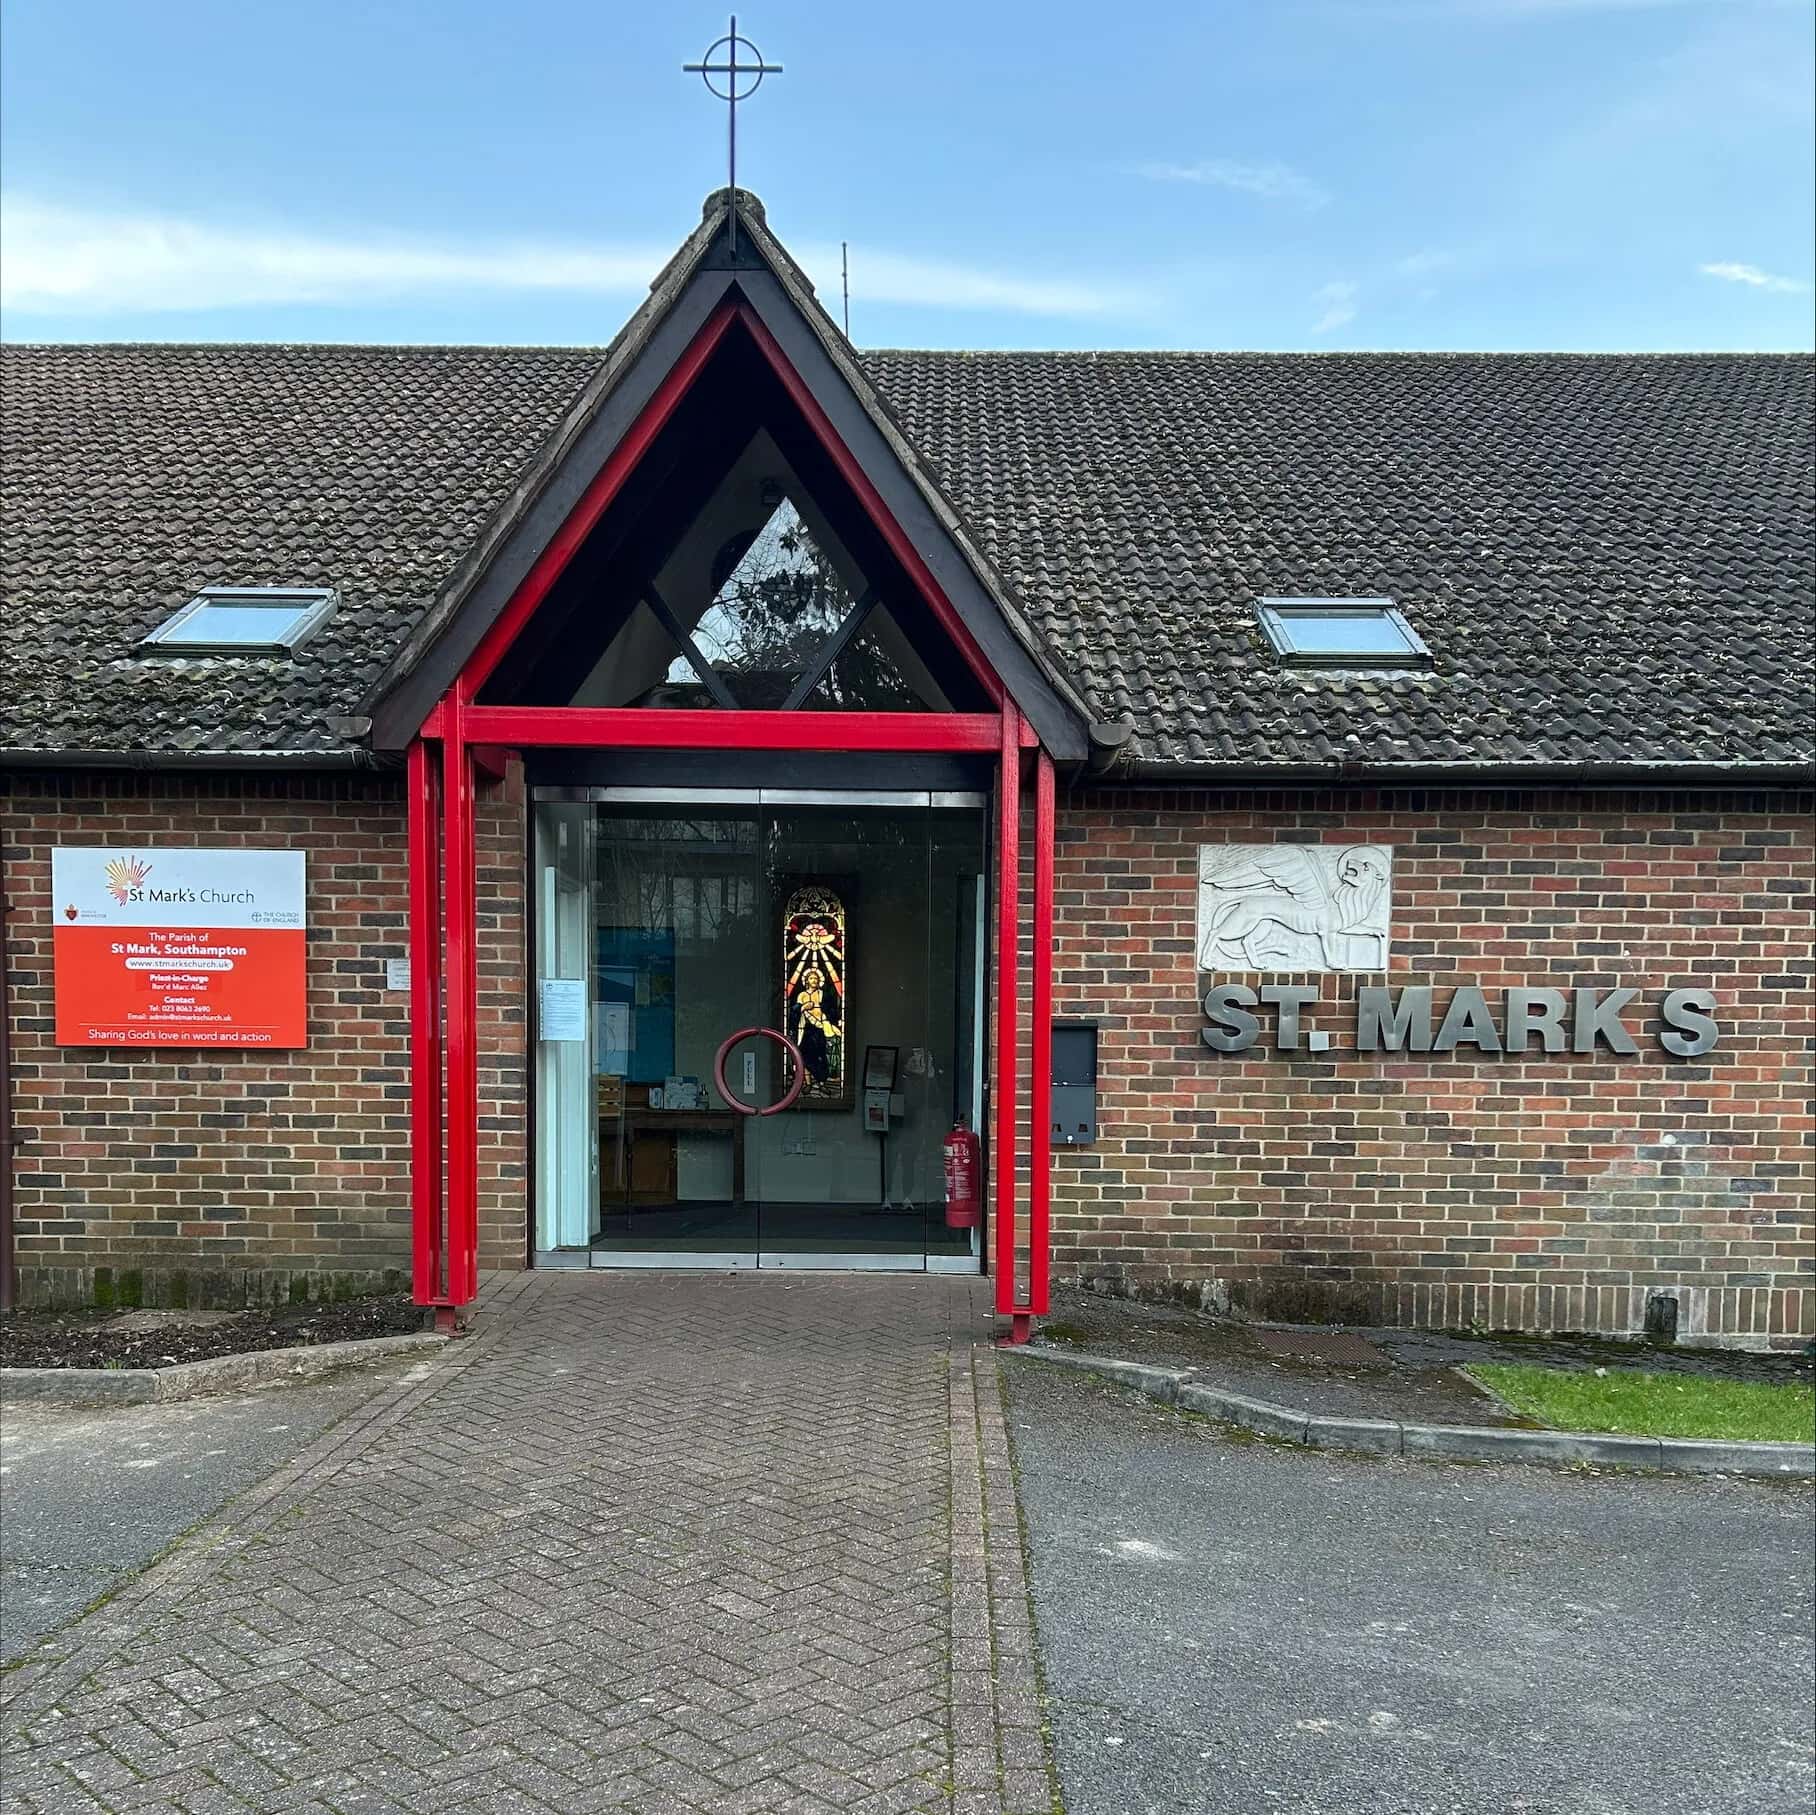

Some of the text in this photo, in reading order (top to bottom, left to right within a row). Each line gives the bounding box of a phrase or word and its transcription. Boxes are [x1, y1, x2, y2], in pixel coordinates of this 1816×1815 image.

[129, 888, 254, 904] St Mark's Church
[149, 932, 208, 942] The Parish of
[111, 943, 247, 958] St Mark, Southampton
[130, 960, 229, 969] www.stmarkschurch.uk
[149, 974, 209, 983] Priest-in-Charge
[164, 995, 195, 1004] Contact
[1201, 984, 1330, 1053] ST.
[88, 1029, 272, 1042] Sharing God's love in word and action
